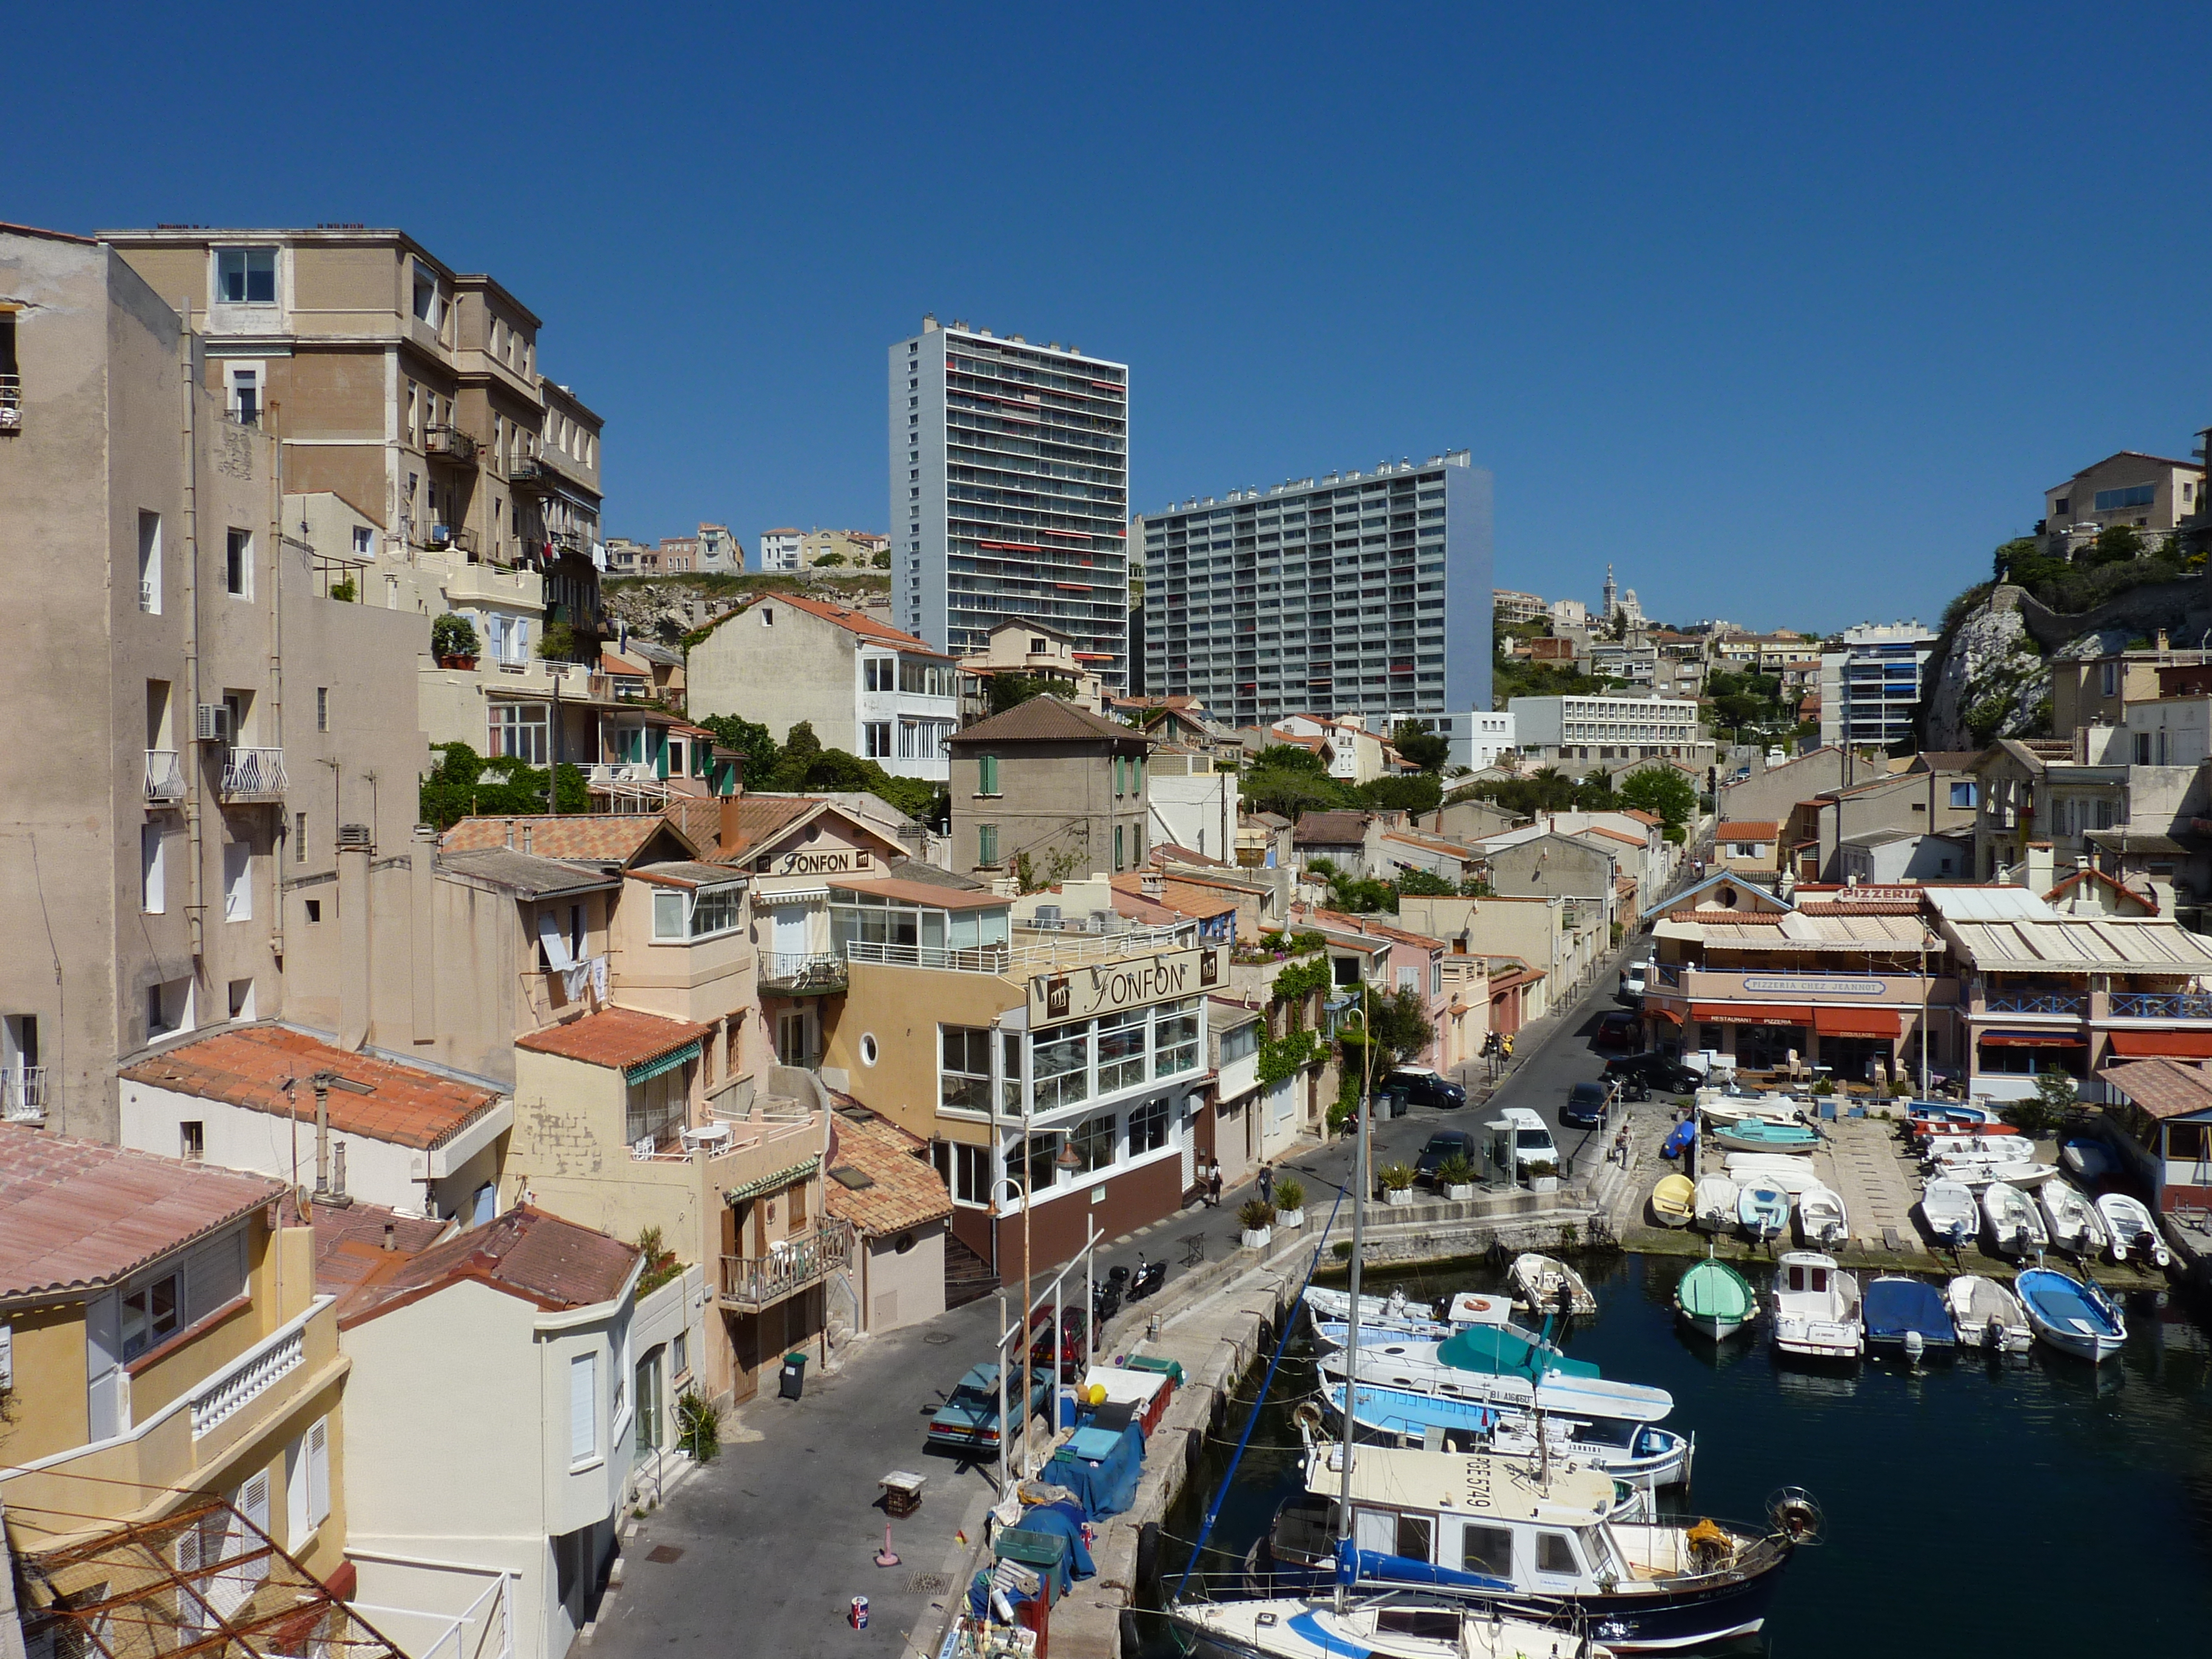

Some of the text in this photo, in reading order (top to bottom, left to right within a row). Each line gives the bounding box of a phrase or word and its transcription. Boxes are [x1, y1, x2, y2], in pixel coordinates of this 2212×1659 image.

[780, 852, 848, 876] FONFON
[1843, 889, 1923, 899] PIZZERIA
[1084, 963, 1182, 1013] FONFON
[1711, 1015, 1752, 1024] RESTAURANT
